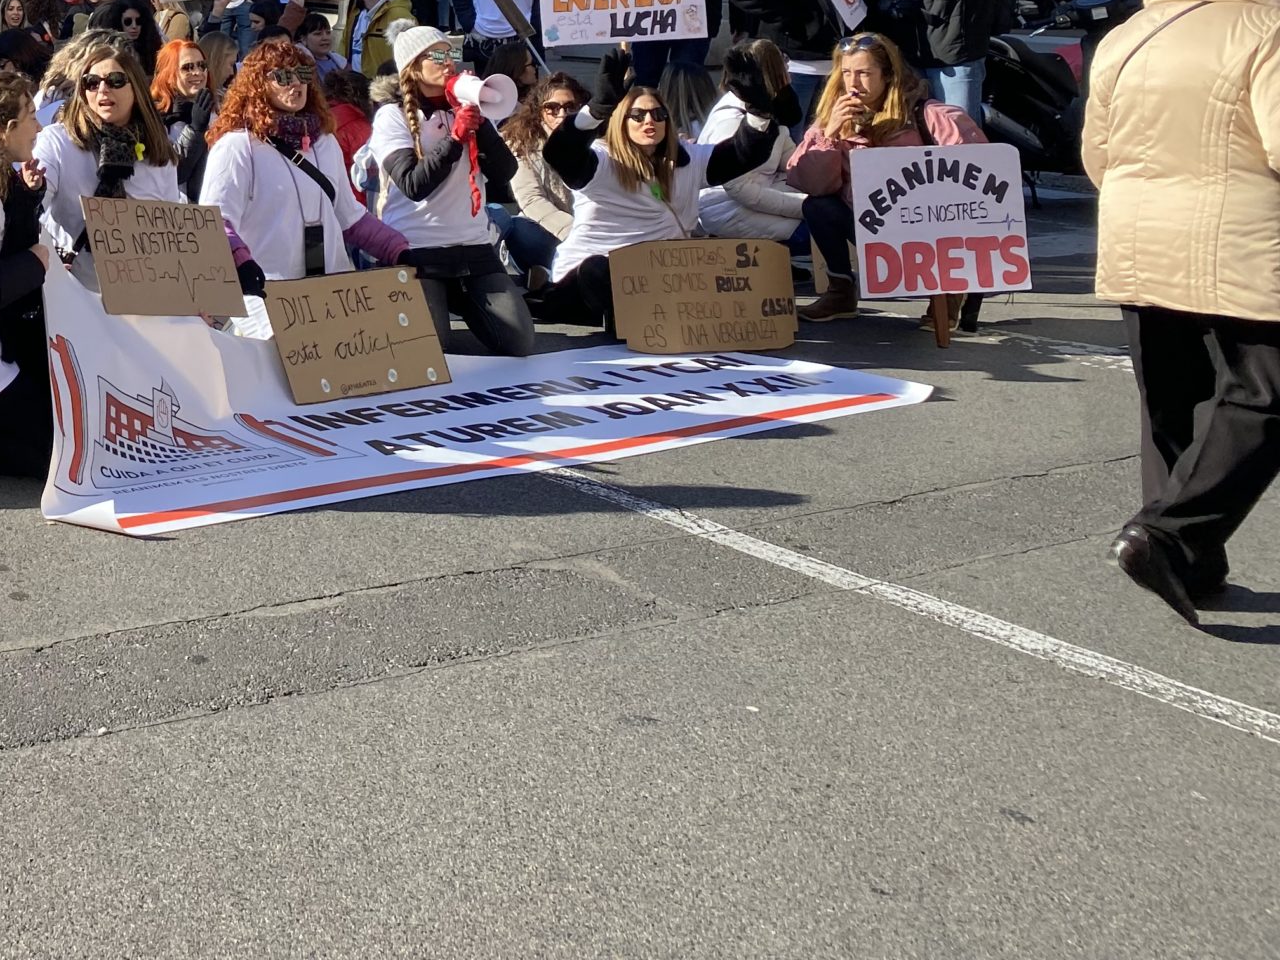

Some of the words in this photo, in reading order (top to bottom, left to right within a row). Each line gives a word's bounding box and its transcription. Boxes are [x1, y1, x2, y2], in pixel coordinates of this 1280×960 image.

[557, 11, 593, 26] está
[610, 8, 677, 38] LUCHA
[570, 28, 589, 40] en
[86, 197, 129, 226] RCP
[135, 204, 218, 232] AVANÇADA
[900, 206, 924, 224] ELS
[927, 201, 988, 223] NOSTRES
[93, 228, 126, 255] ALS
[131, 232, 200, 255] NOSTRES
[104, 256, 159, 285] DRETS
[864, 234, 1030, 294] DRETS
[662, 273, 708, 294] SOMOS
[714, 275, 753, 293] ROLEX
[276, 294, 318, 331] DUI
[325, 302, 336, 320] i
[332, 286, 376, 318] TCAE
[387, 290, 413, 304] en
[652, 303, 668, 321] A
[677, 301, 722, 321] PRECIO
[733, 302, 747, 319] DE
[680, 323, 710, 347] UNA
[286, 341, 323, 366] estat
[289, 375, 621, 432] INFERMERIA
[602, 370, 646, 383] I
[363, 410, 599, 456] ATUREM
[585, 390, 727, 420] JOAN
[706, 372, 834, 398] XXIII
[100, 465, 152, 479] CUIDA
[169, 463, 204, 472] QUI
[204, 459, 224, 469] ET
[227, 452, 283, 465] CUIDA
[111, 479, 184, 495] REANIMEM
[184, 476, 205, 484] ELS
[206, 467, 269, 480] NOSTRES
[269, 461, 309, 472] DRETS
